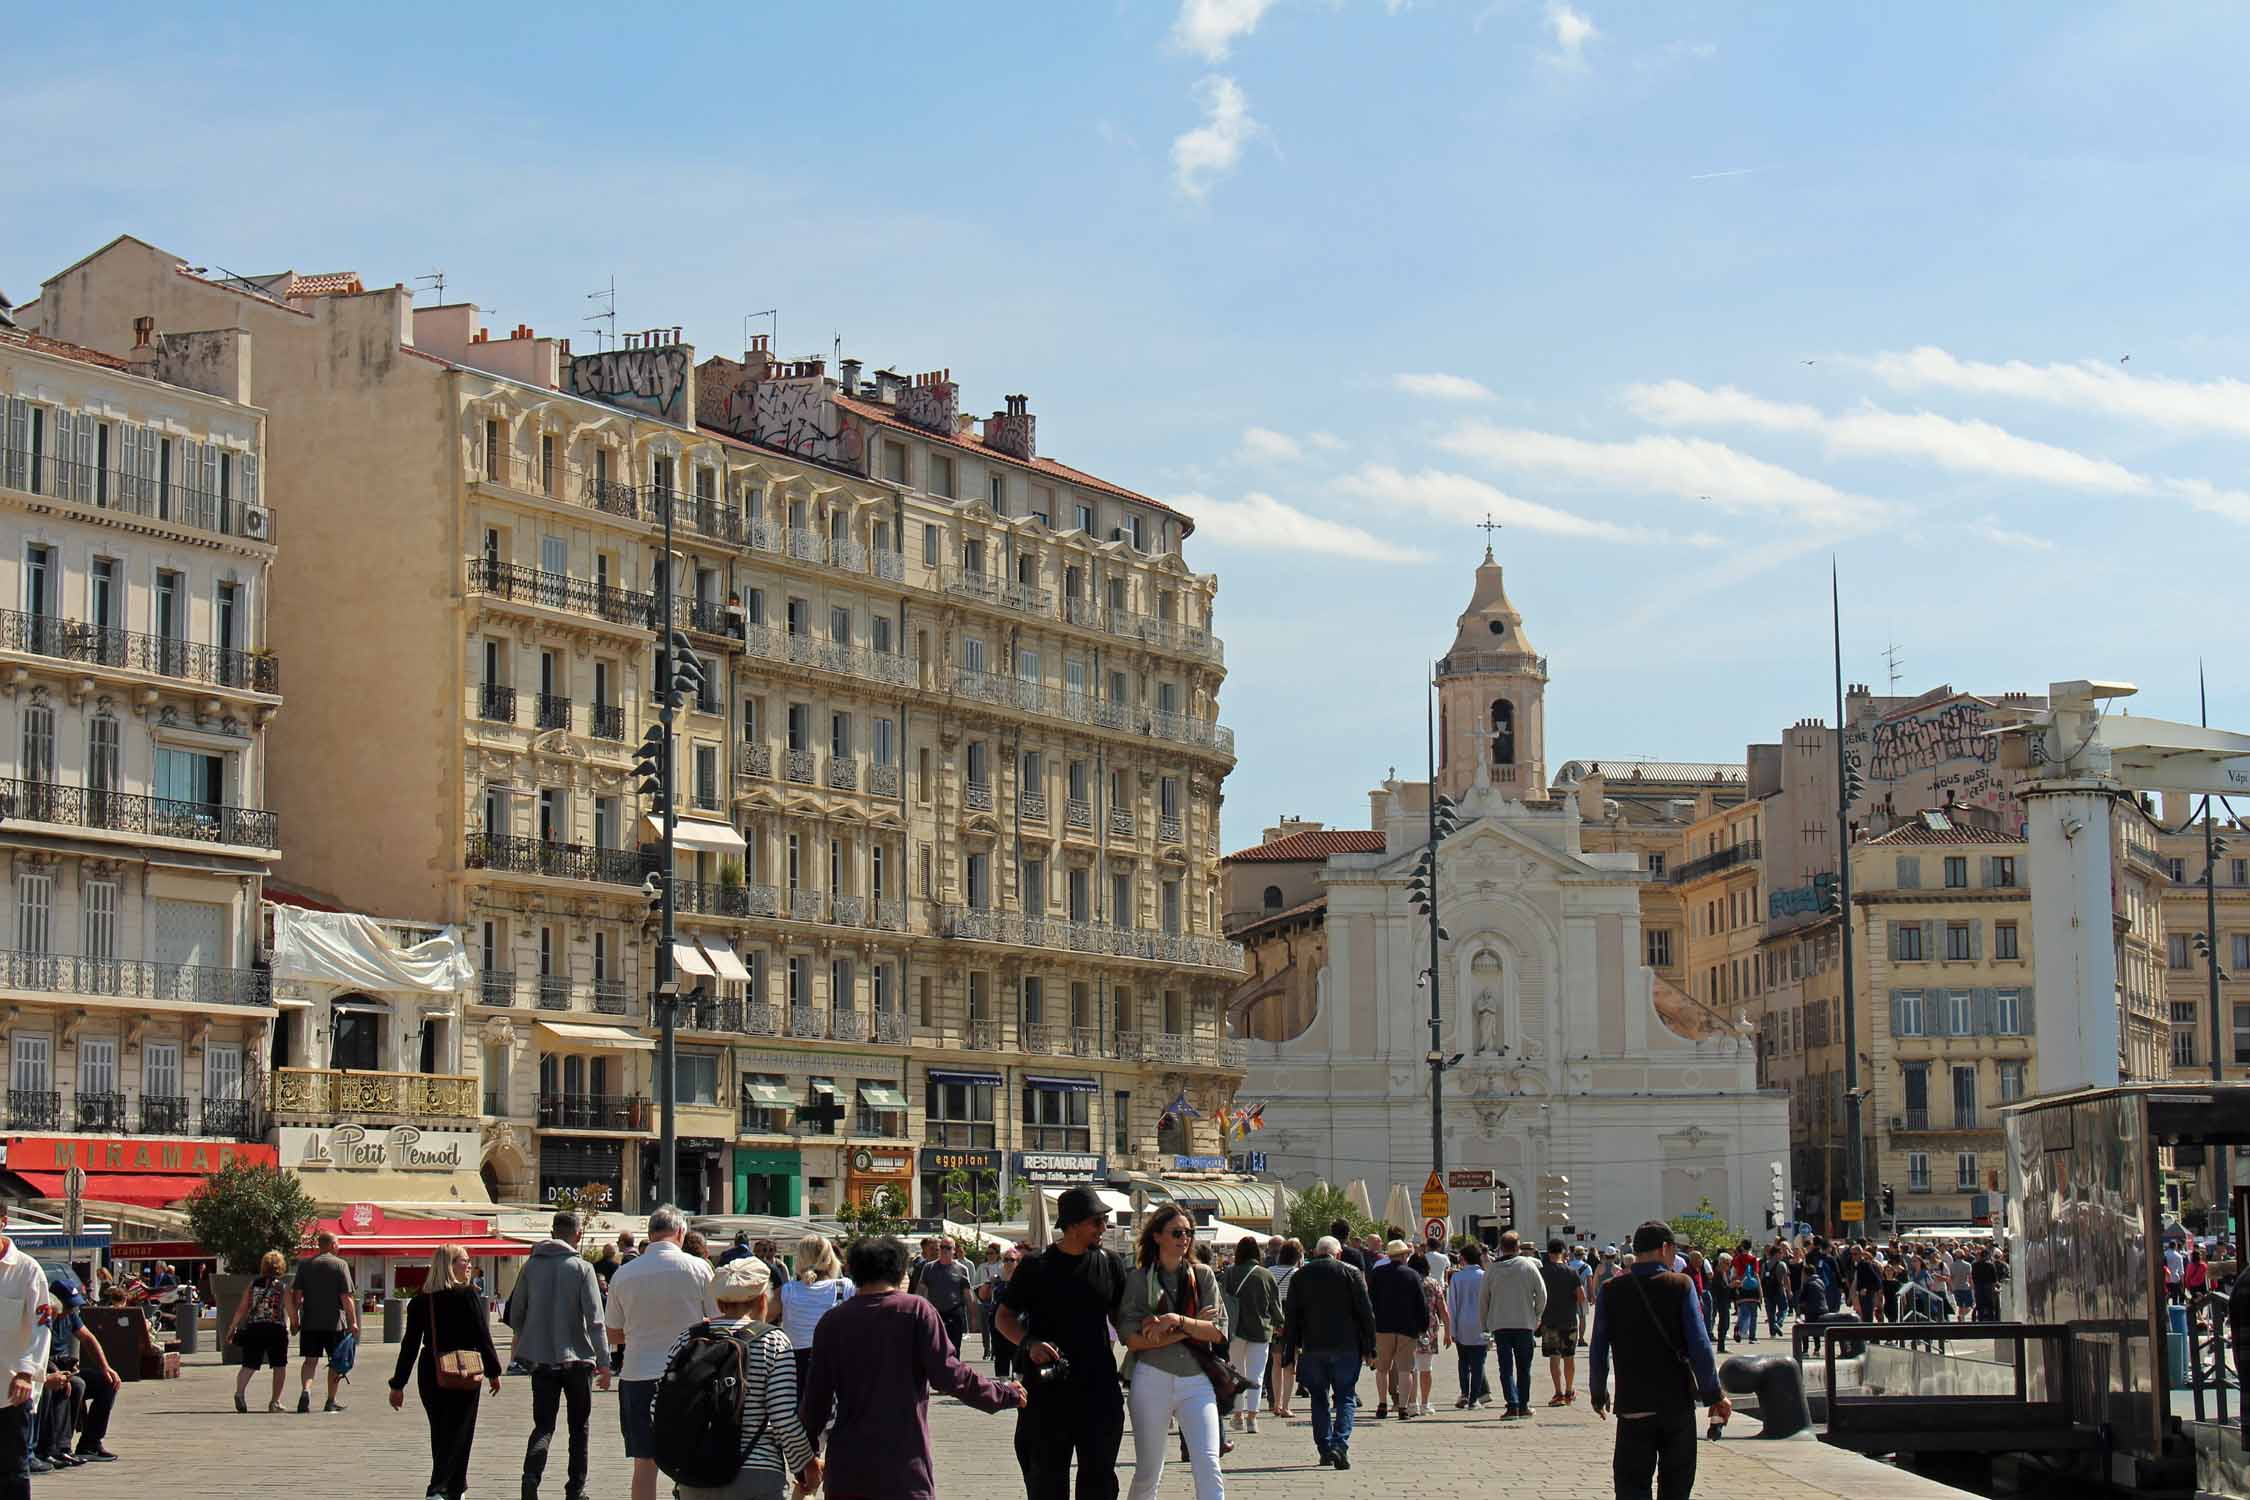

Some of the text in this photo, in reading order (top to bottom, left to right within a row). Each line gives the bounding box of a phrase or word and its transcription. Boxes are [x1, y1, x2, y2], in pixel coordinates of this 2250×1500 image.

[305, 1124, 462, 1166] Le Petit Pernod
[935, 1153, 988, 1169] eggplant
[1023, 1155, 1099, 1170] RESTAURANT
[1430, 1226, 1441, 1237] 30
